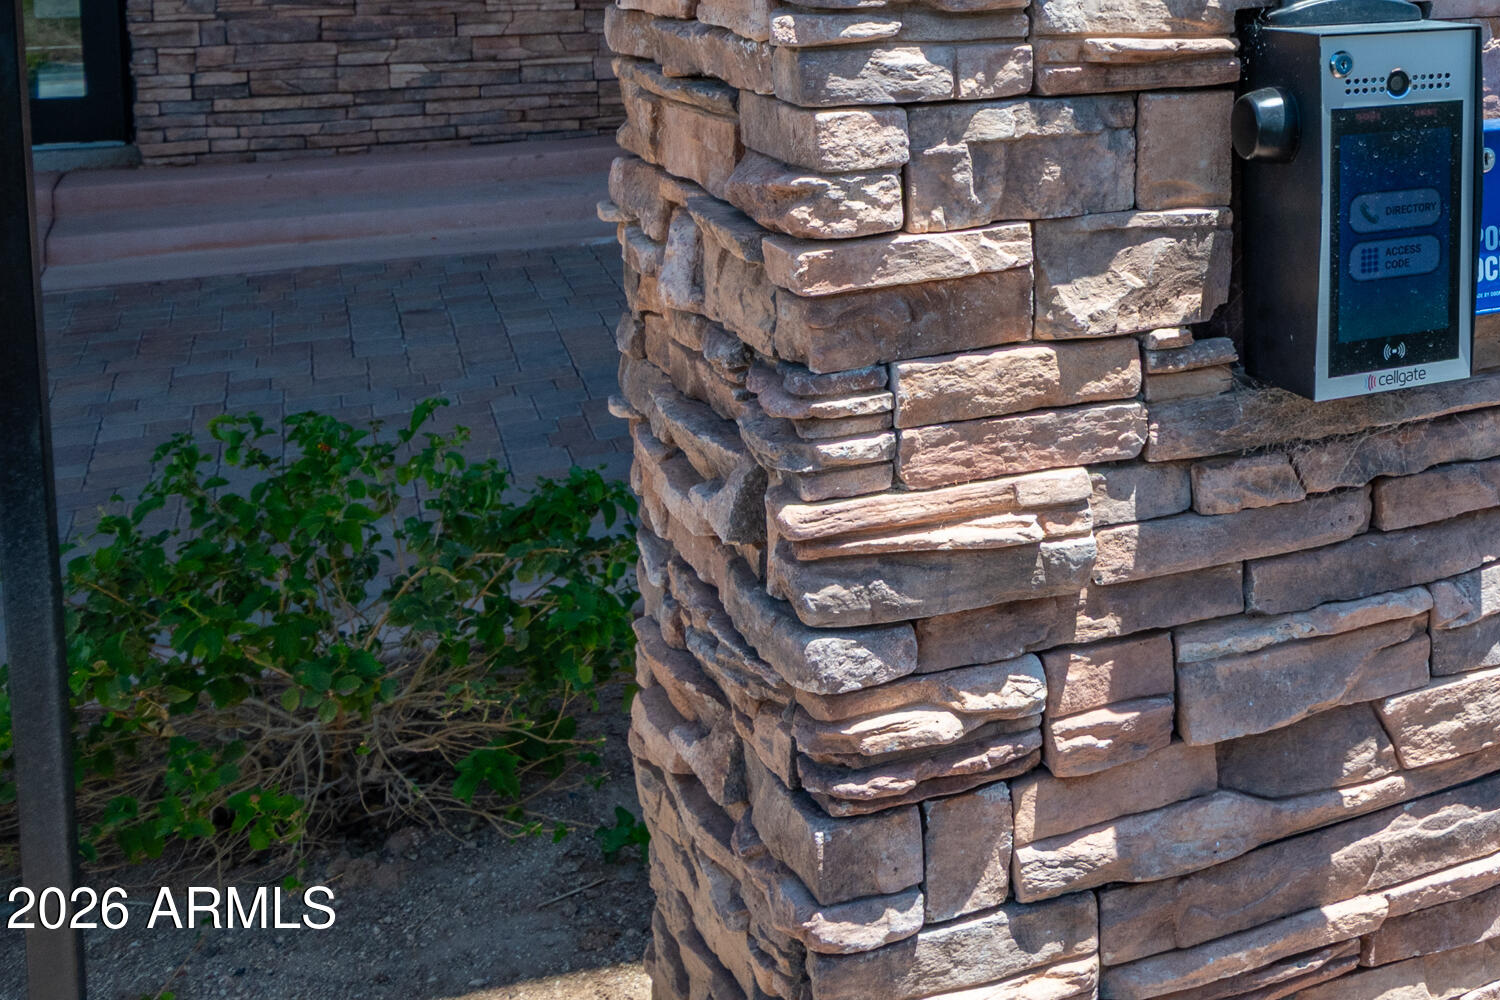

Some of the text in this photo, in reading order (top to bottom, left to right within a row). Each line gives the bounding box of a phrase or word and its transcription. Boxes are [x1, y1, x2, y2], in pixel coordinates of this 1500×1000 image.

[1385, 201, 1437, 216] DIRECTORY
[1385, 244, 1422, 256] ACCESS
[1385, 258, 1410, 270] CODE
[1378, 368, 1427, 386] cellgate
